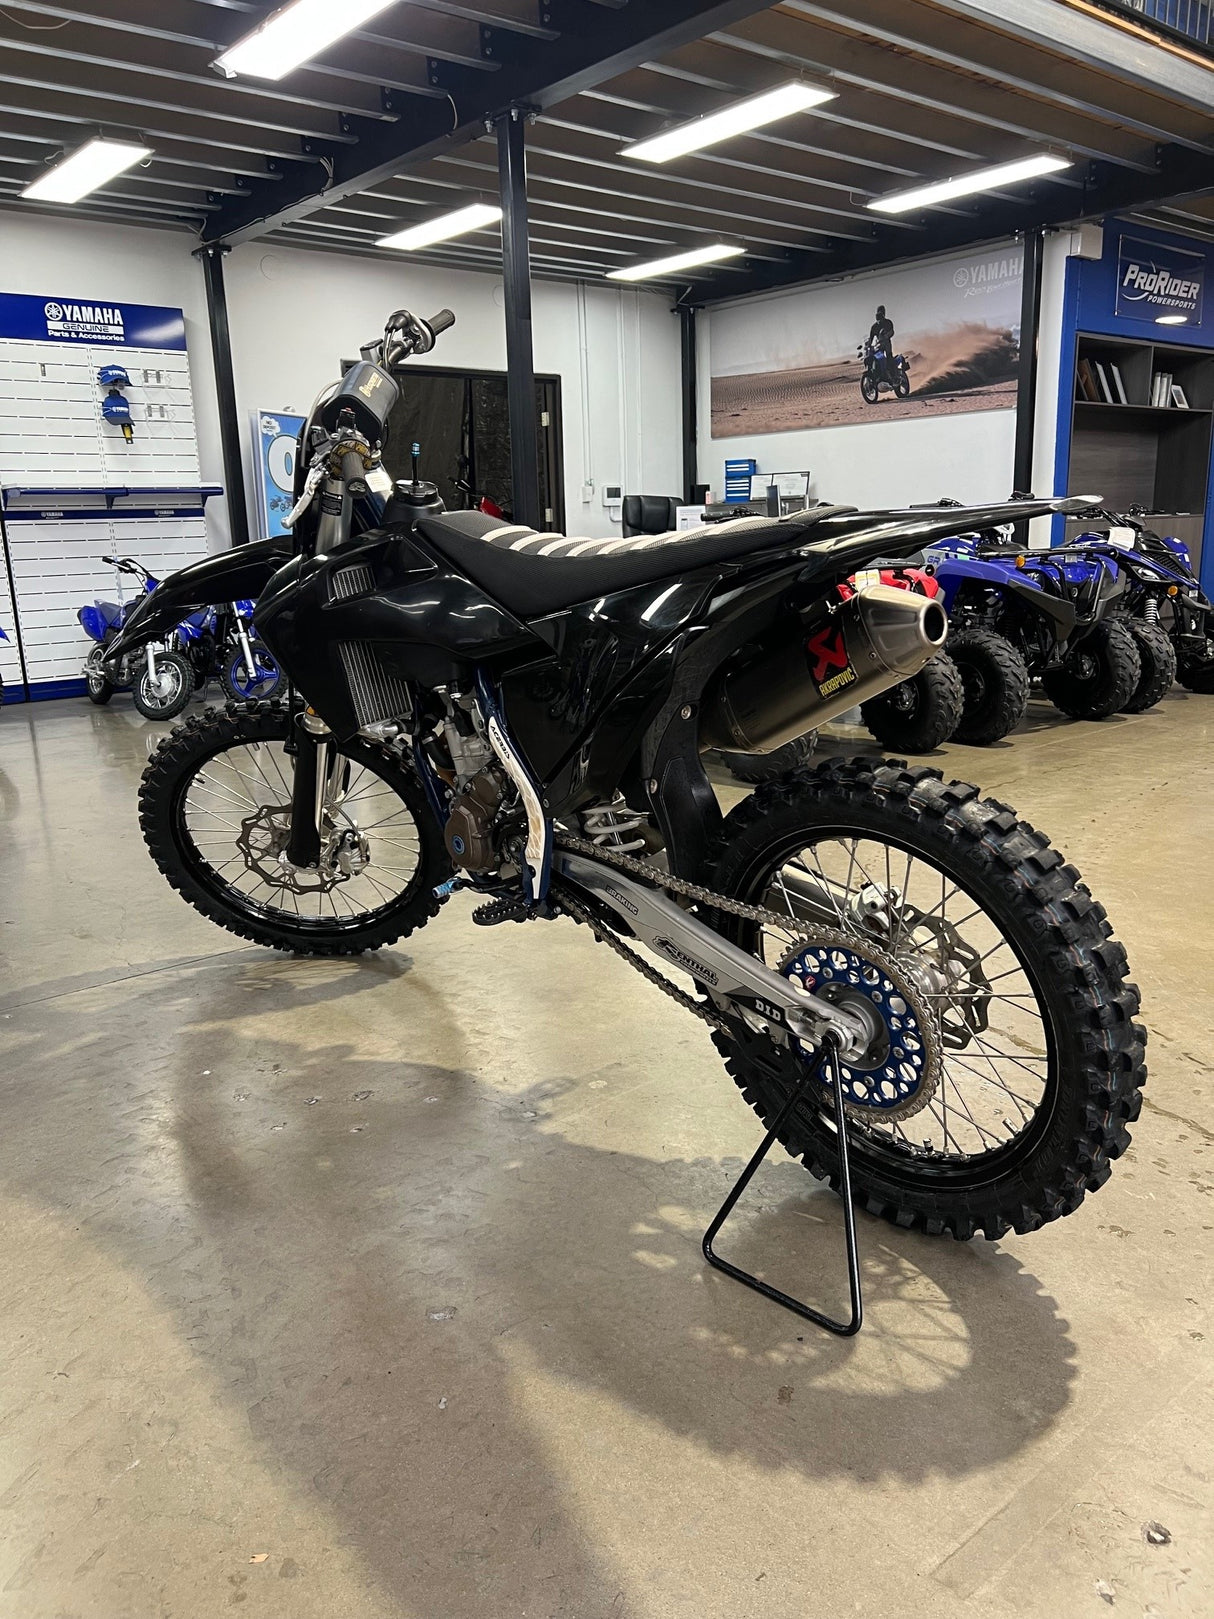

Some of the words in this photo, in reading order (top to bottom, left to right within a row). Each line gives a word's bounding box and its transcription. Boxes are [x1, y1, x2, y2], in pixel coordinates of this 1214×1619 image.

[1147, 294, 1196, 310] POWERSPORTS
[62, 304, 124, 325] YAMAHA
[62, 322, 110, 333] GENUINE
[48, 330, 70, 338] Parts
[78, 332, 125, 342] Accessories
[605, 885, 639, 916] BRAKING
